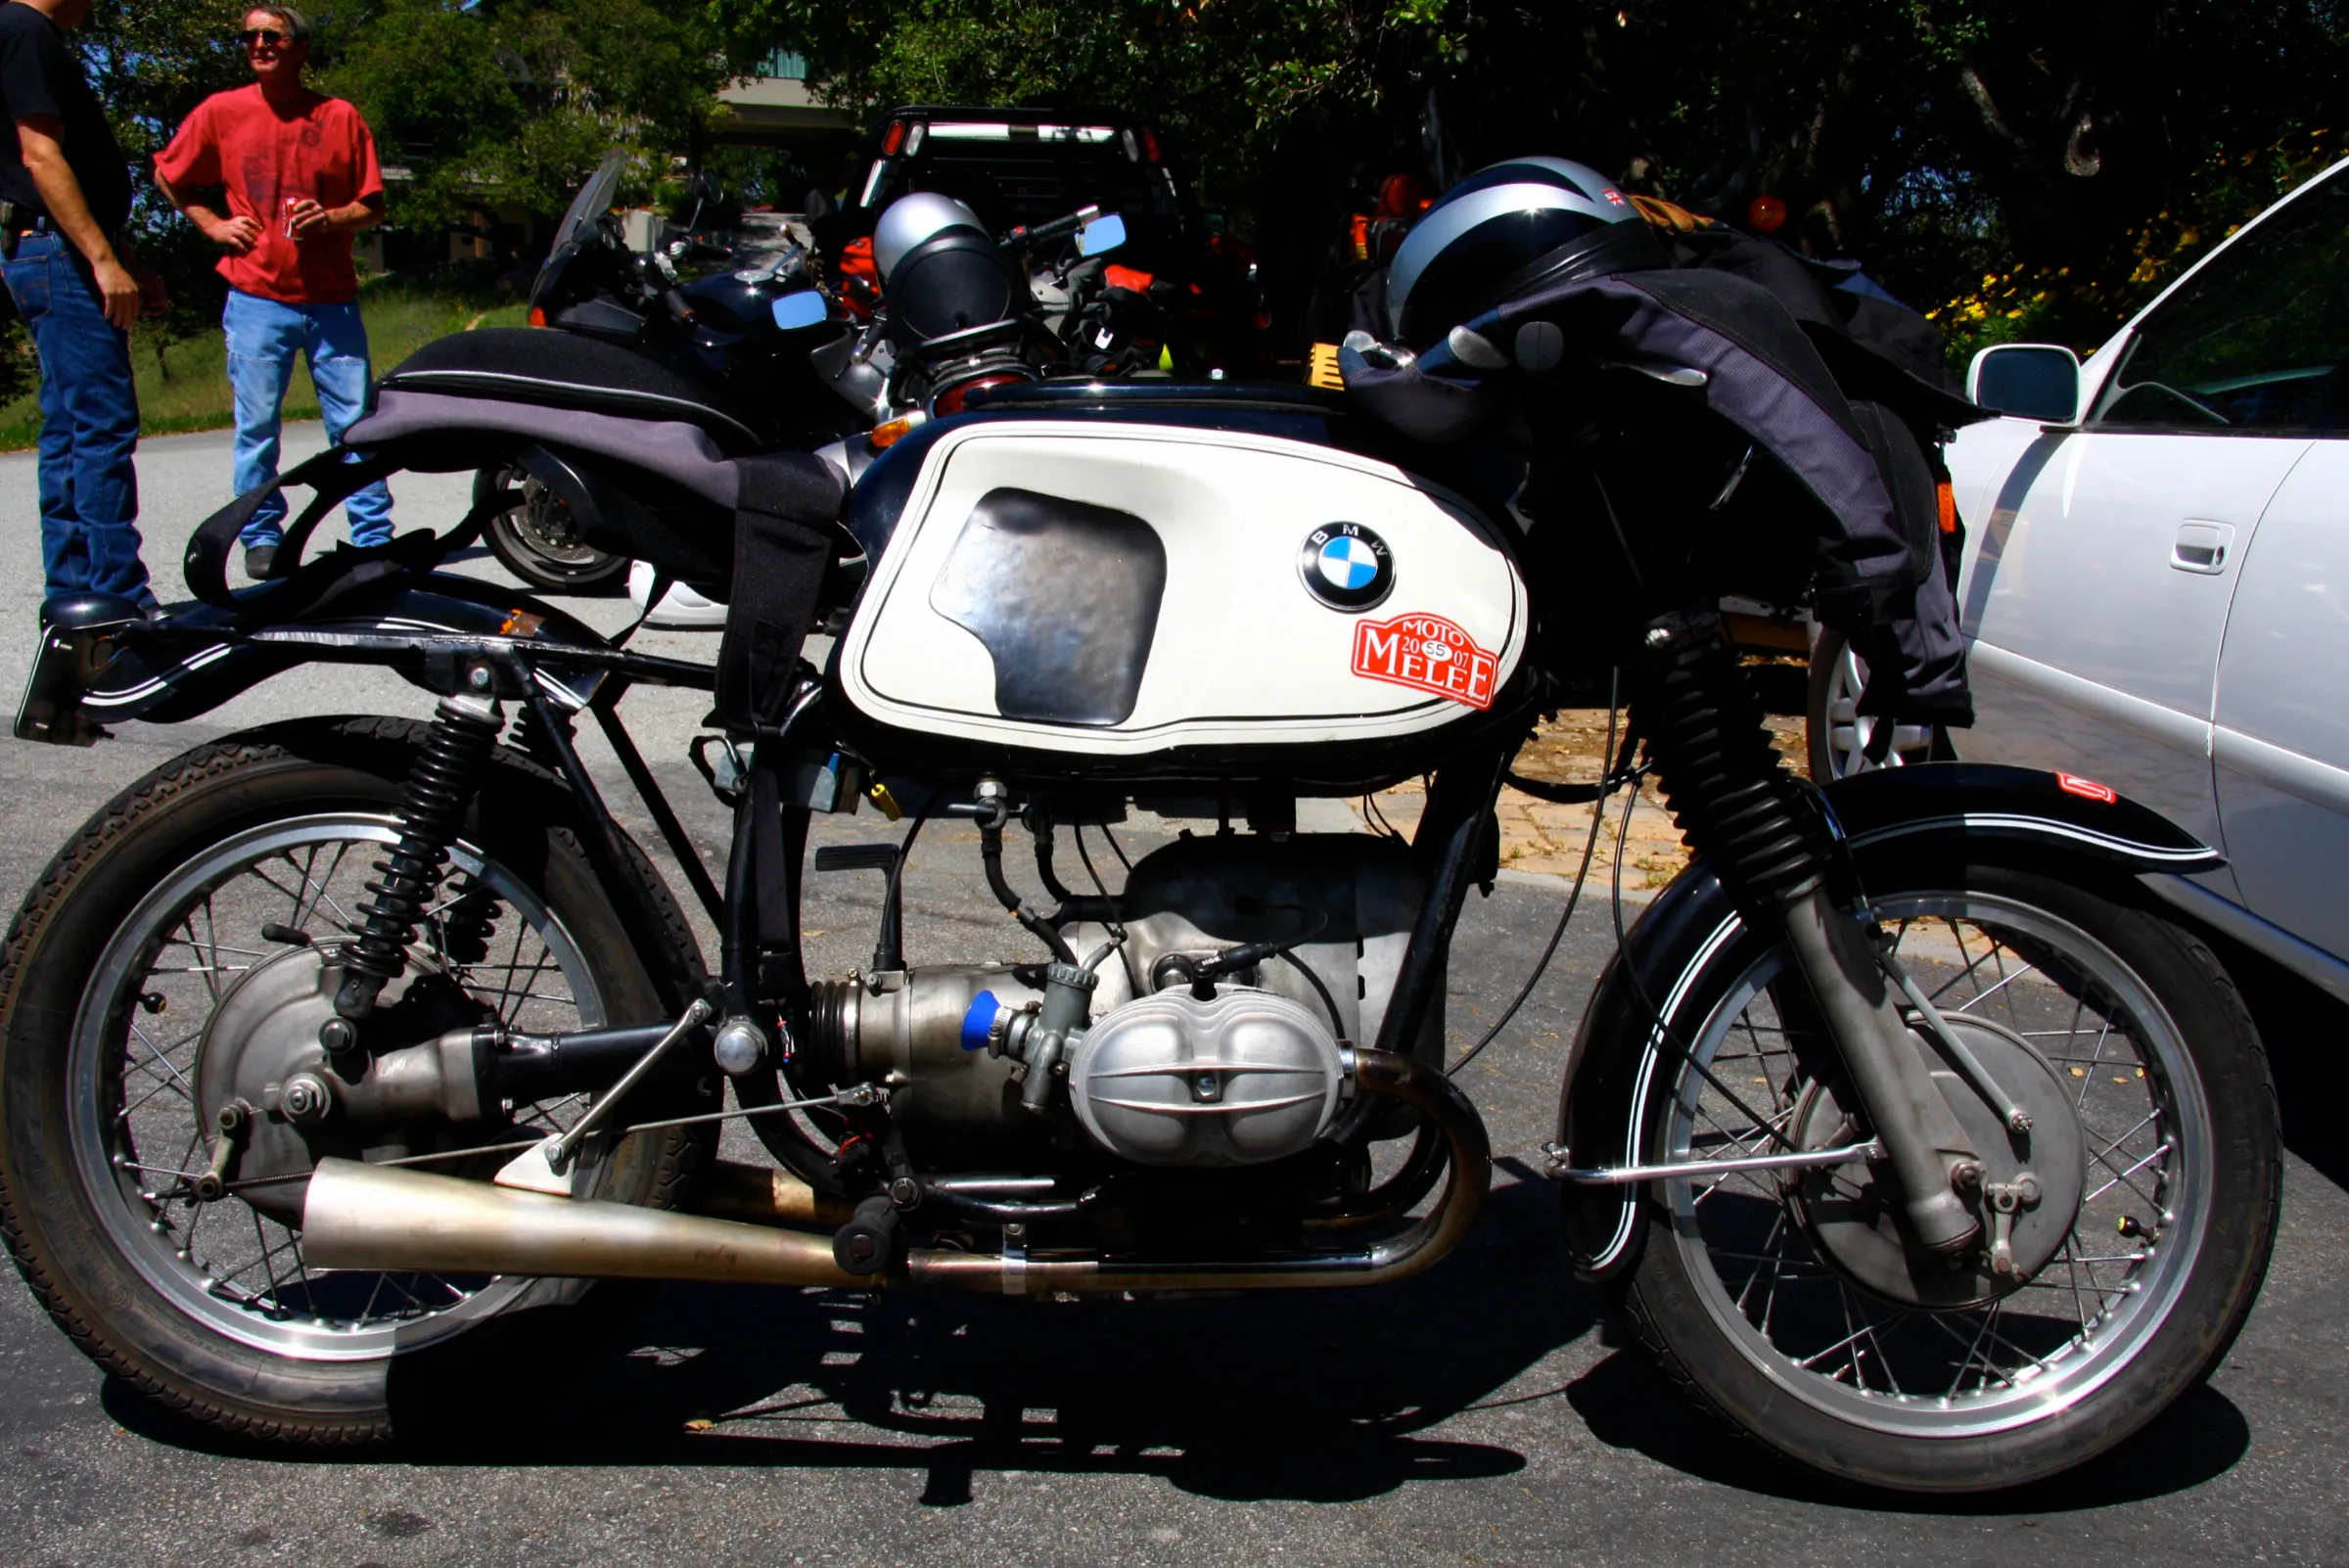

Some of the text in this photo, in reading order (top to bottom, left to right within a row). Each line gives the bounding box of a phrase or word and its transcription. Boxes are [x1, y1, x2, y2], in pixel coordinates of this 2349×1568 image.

[1312, 524, 1387, 556] BMW
[1403, 620, 1464, 646] MOTO
[1361, 627, 1493, 701] MELEE
[1402, 636, 1420, 654] 20
[1453, 650, 1469, 668] 07
